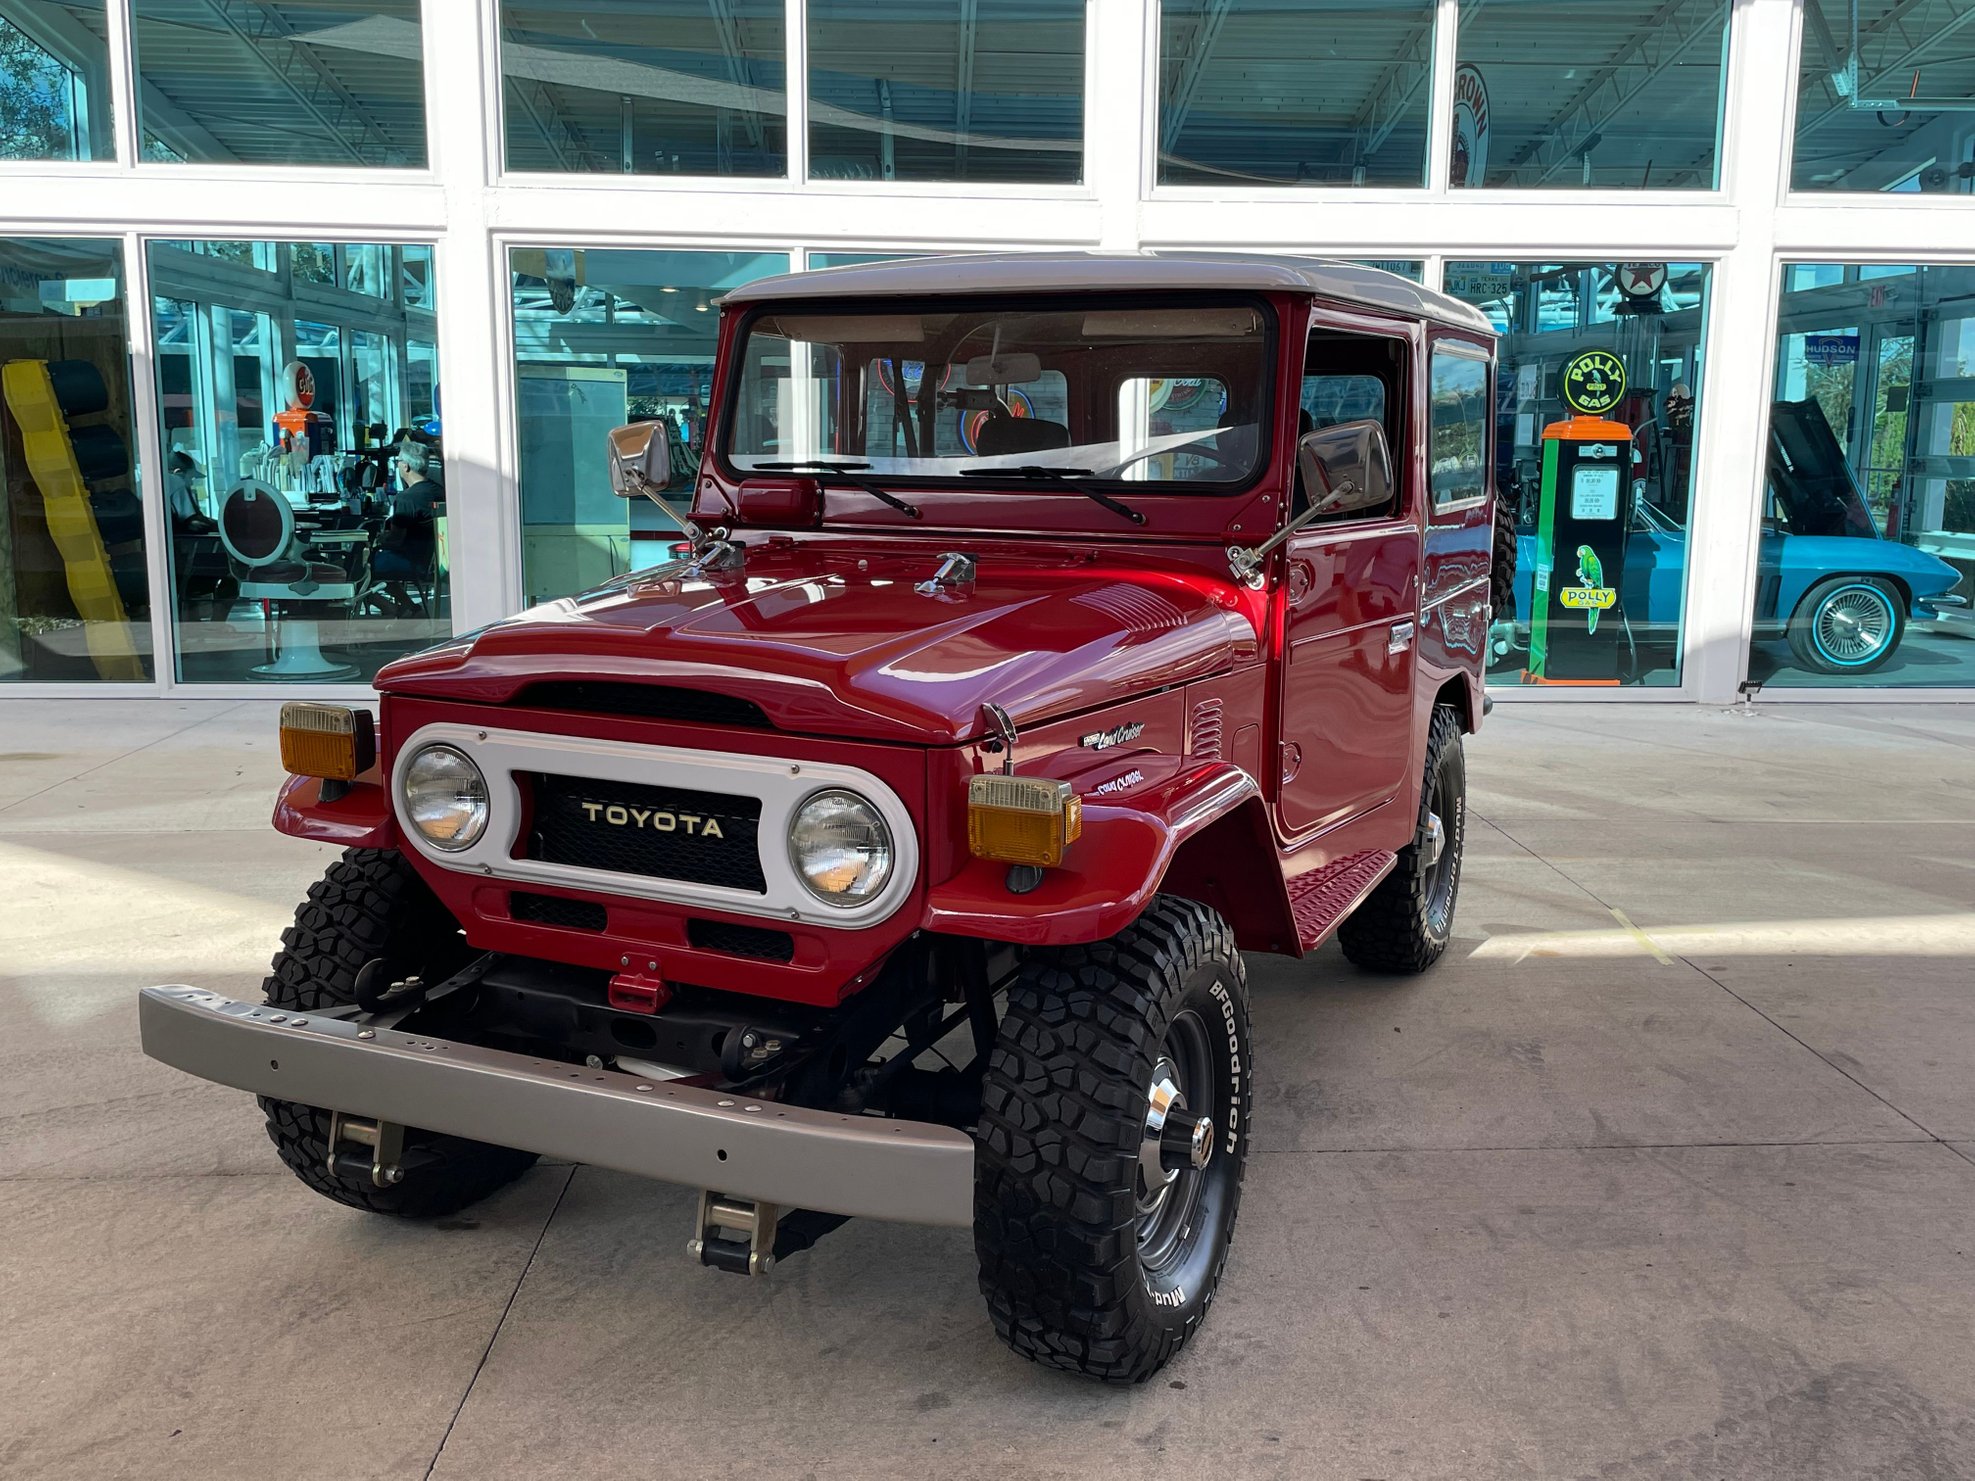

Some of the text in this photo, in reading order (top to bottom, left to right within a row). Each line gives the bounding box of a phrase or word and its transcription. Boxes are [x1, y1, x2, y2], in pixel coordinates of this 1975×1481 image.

[1454, 74, 1487, 139] ROWN
[1470, 282, 1508, 295] HRC-325
[1806, 345, 1856, 354] HUDSON
[1571, 356, 1622, 383] POLLY
[1578, 394, 1611, 408] GAS
[1567, 591, 1611, 603] POLLY
[1097, 730, 1118, 750] Land
[1117, 723, 1145, 744] Cruiser
[581, 801, 724, 839] TOYOTA
[1441, 796, 1462, 919] Mud-Terrain
[1208, 979, 1242, 1155] BFGoodrich
